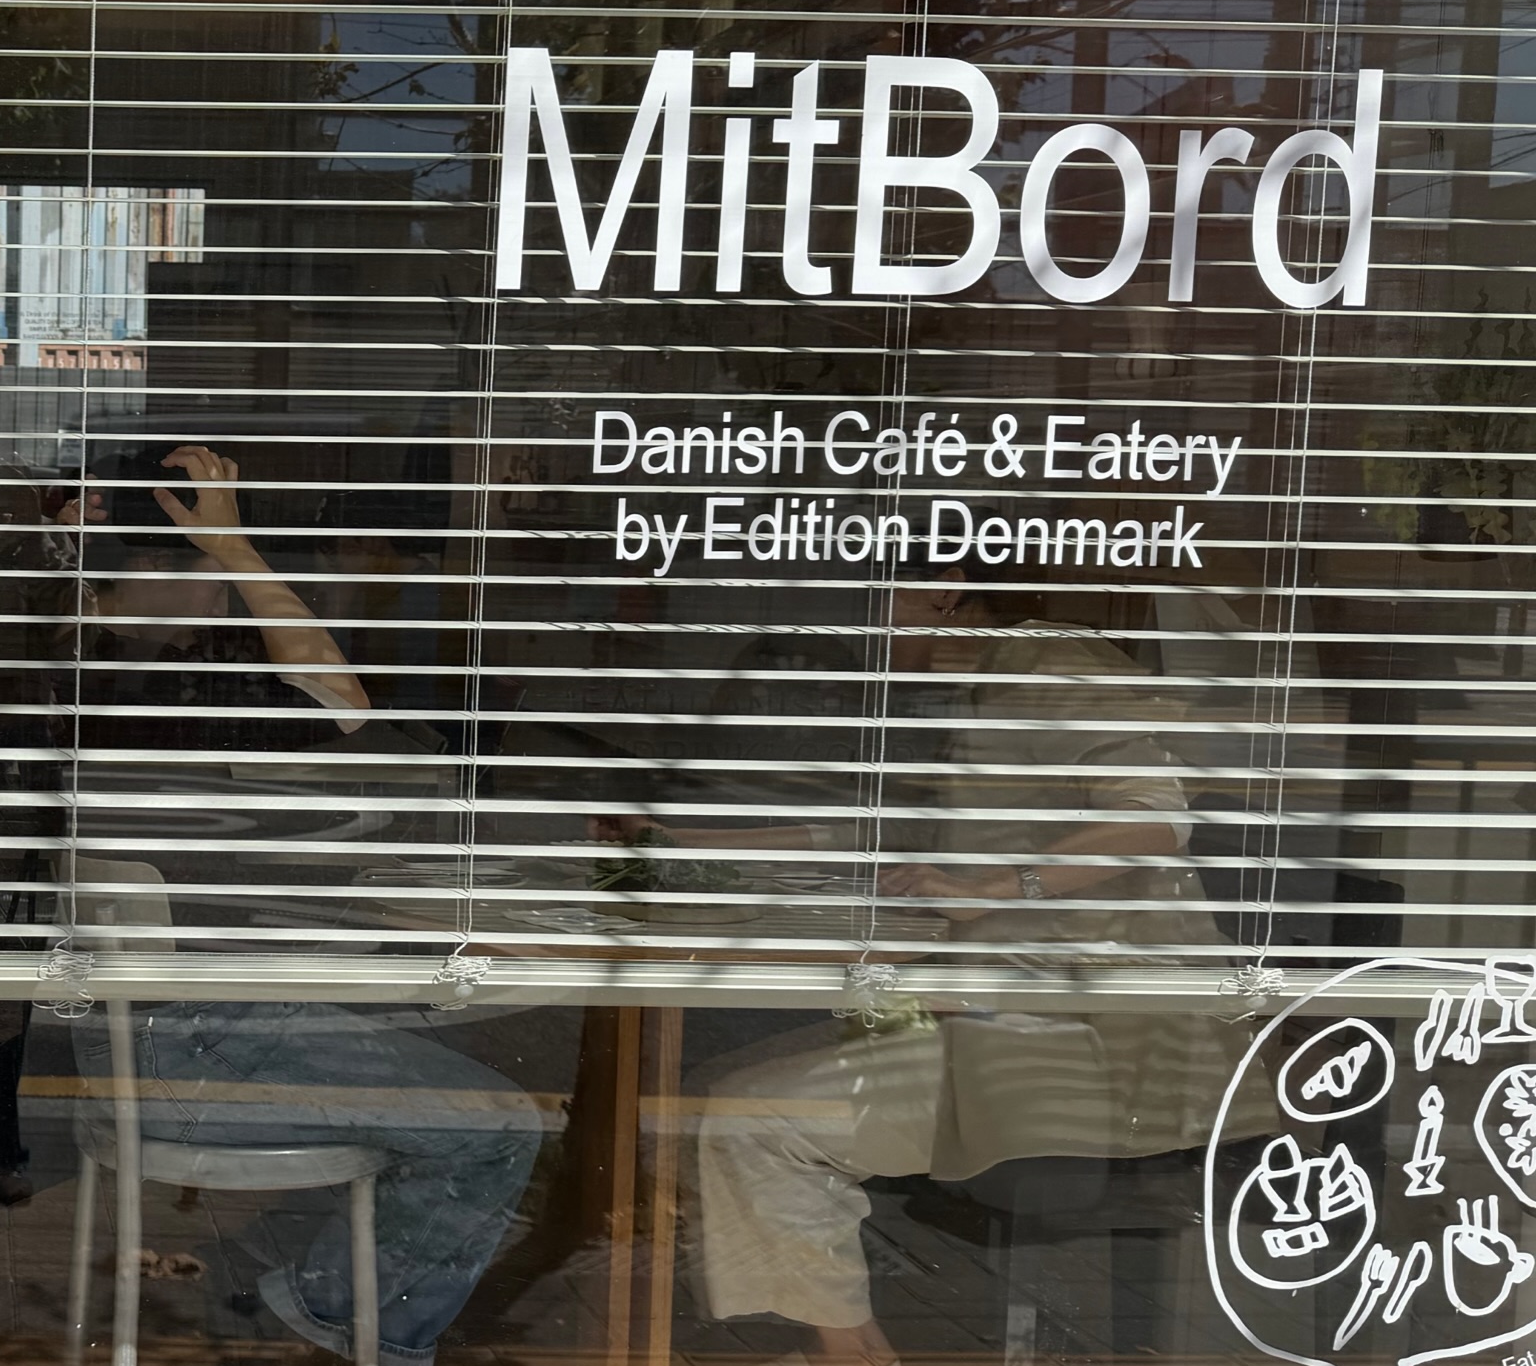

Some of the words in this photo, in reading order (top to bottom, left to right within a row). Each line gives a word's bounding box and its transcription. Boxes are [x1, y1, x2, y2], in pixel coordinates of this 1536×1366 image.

[494, 45, 1386, 310] MitBord
[590, 409, 808, 477] Danish
[822, 410, 968, 479] Café
[982, 415, 1025, 479] &
[1043, 415, 1244, 498] Eatery
[614, 497, 690, 579] by
[701, 497, 910, 565] Edition
[927, 499, 1205, 571] Denmark
